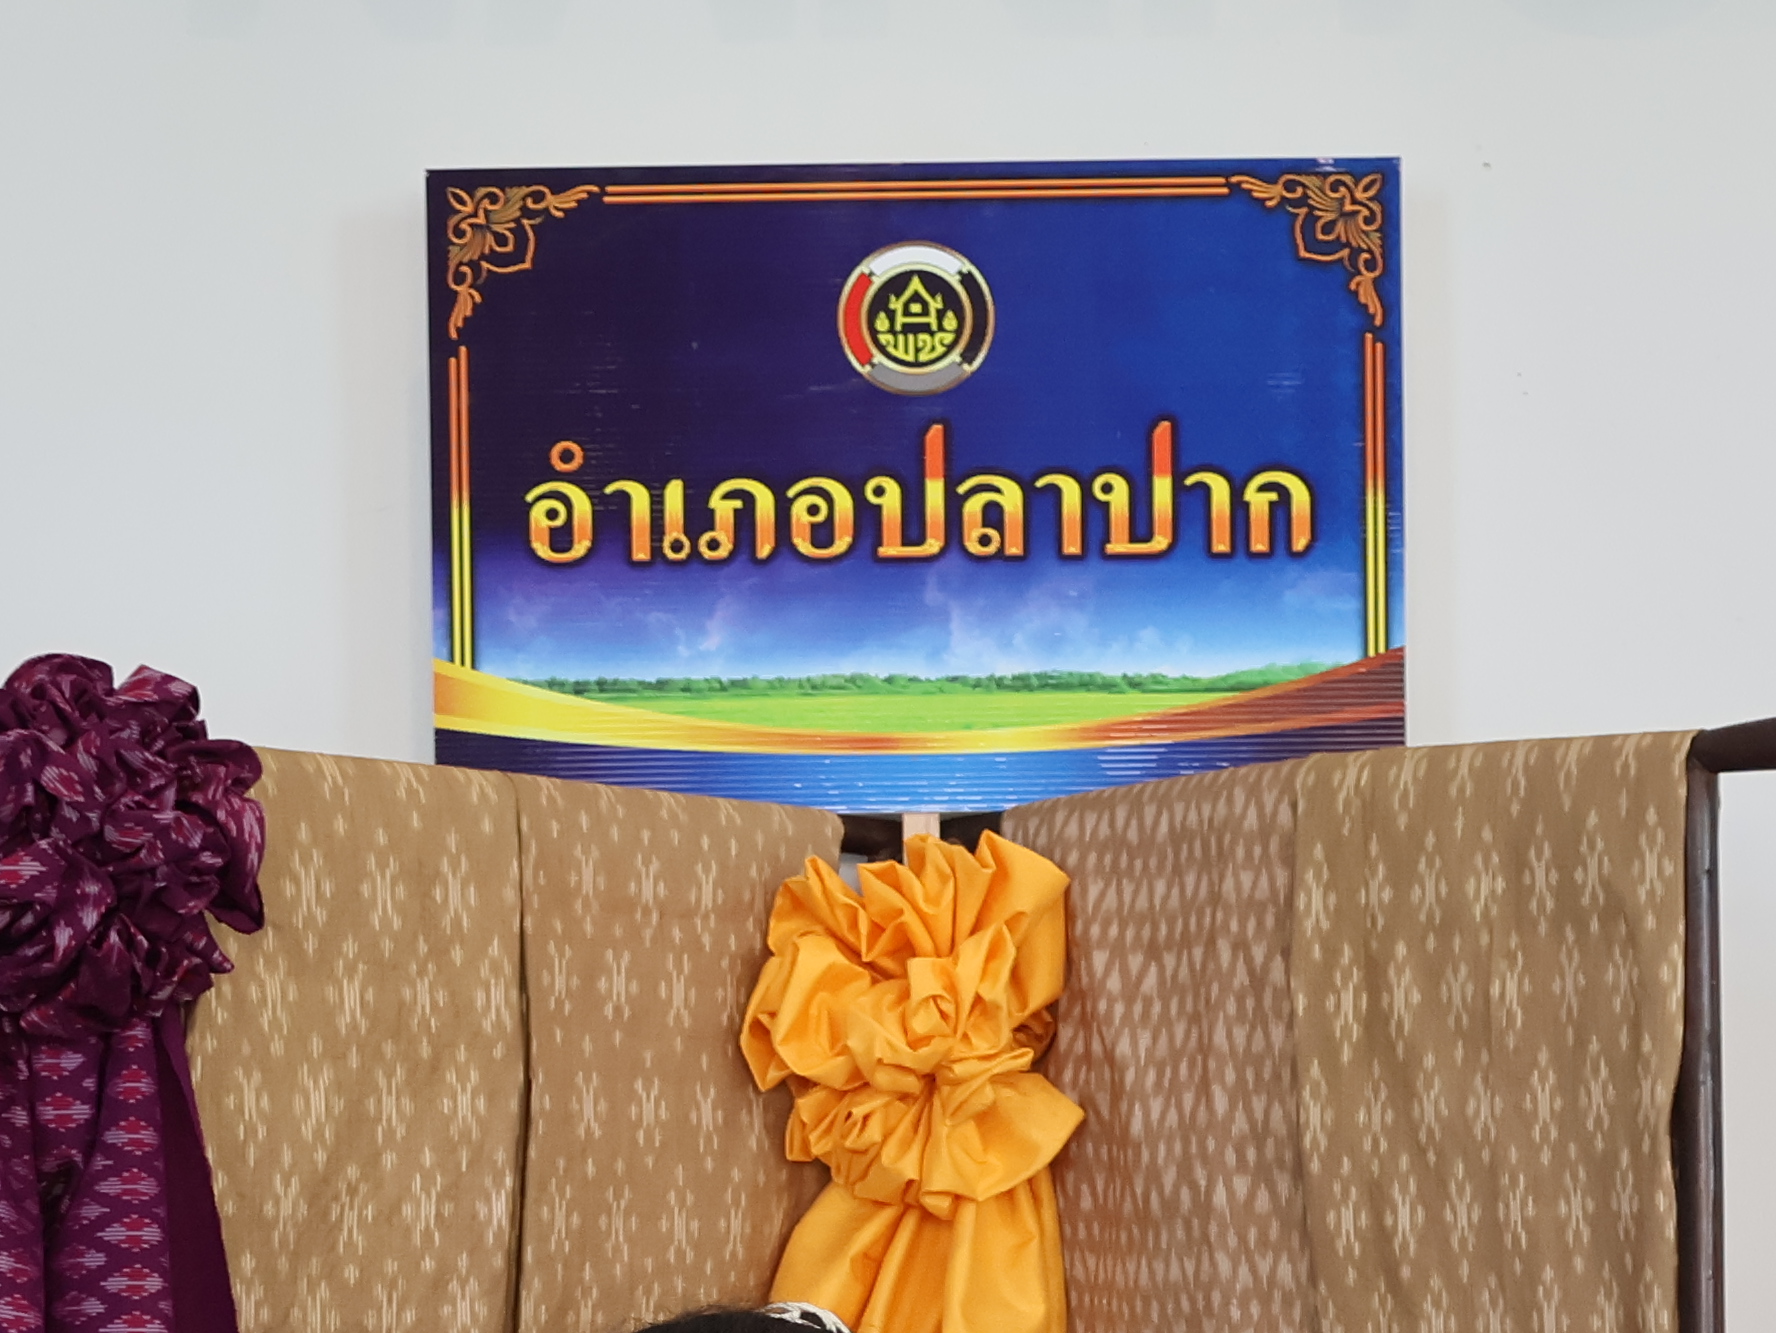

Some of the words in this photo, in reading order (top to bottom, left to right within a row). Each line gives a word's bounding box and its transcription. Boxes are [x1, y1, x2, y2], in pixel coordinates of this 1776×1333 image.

[524, 420, 1313, 564] อำเภอปลาปาก
